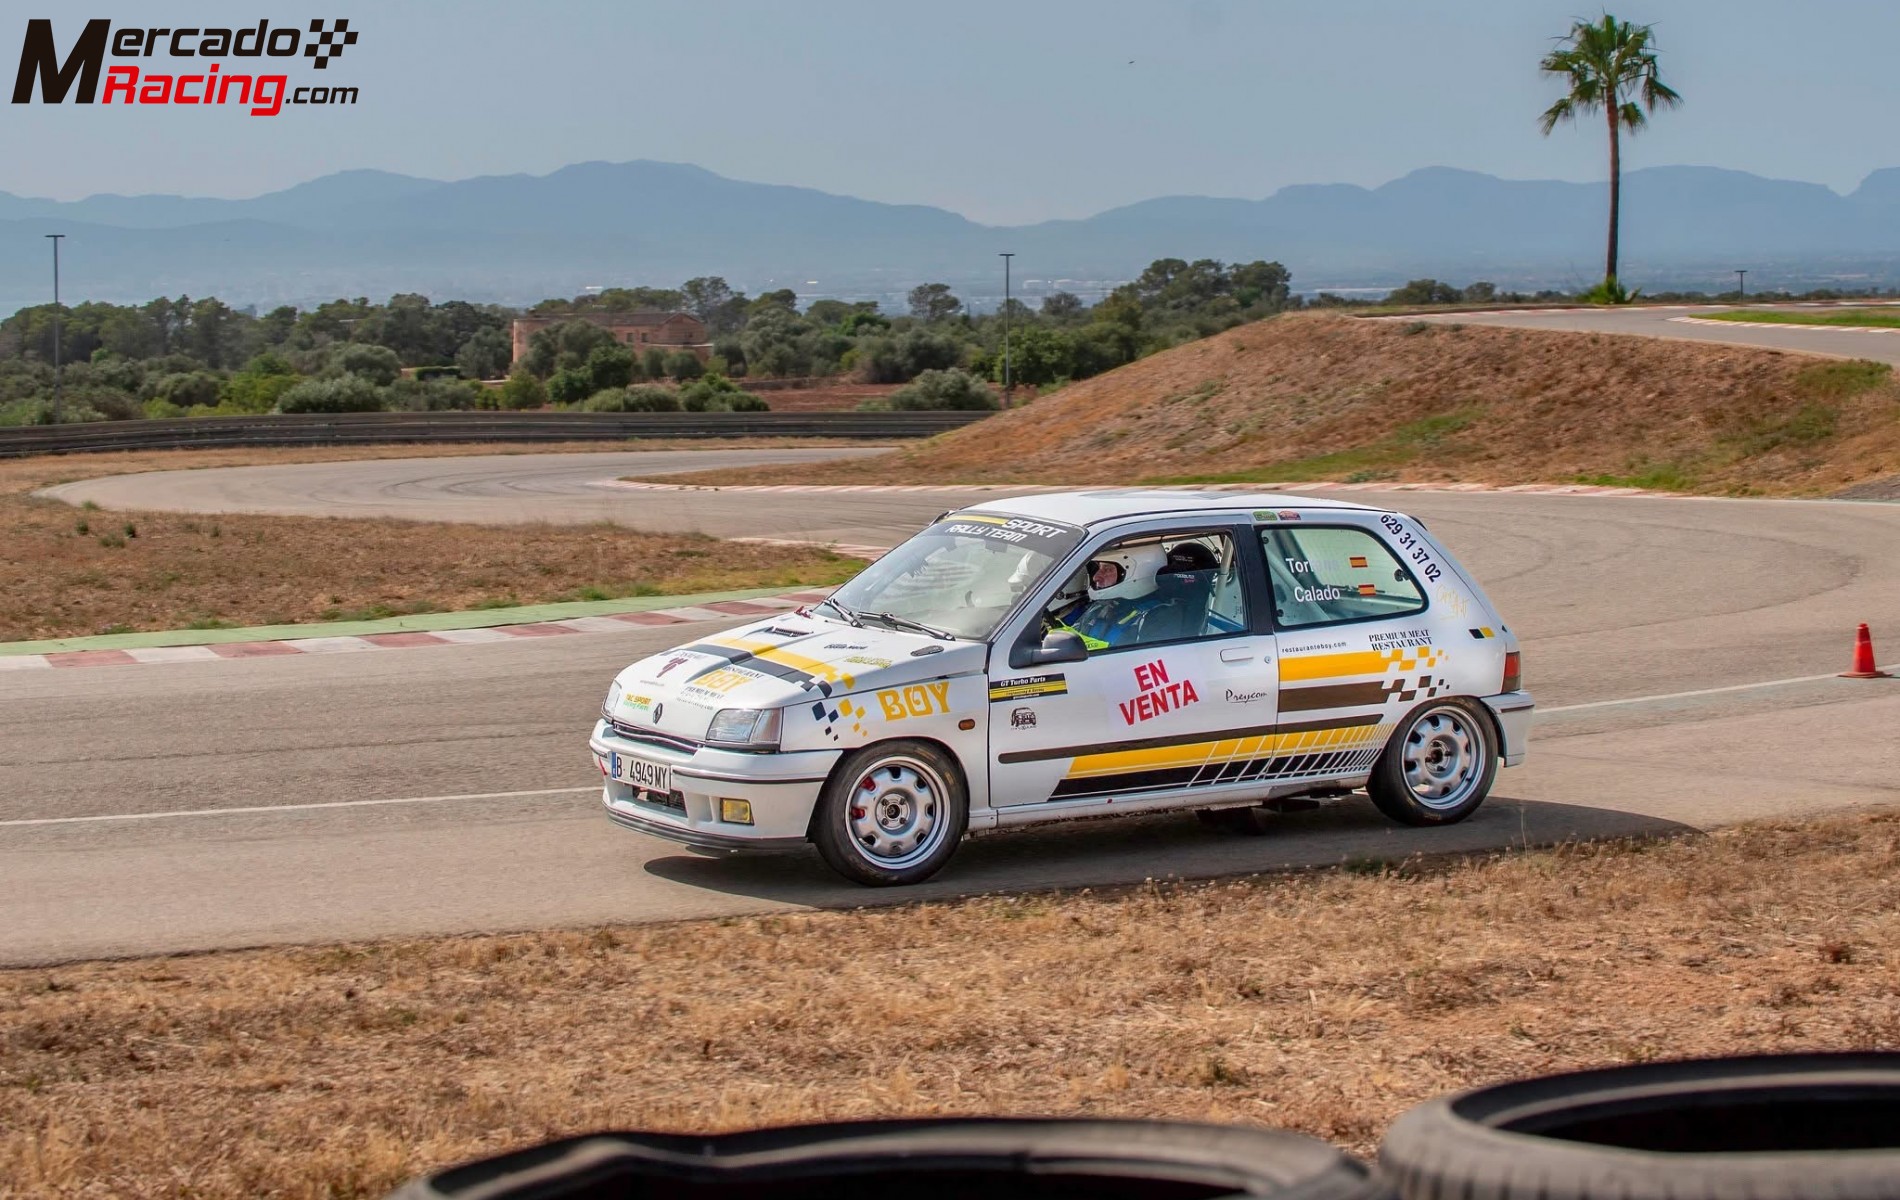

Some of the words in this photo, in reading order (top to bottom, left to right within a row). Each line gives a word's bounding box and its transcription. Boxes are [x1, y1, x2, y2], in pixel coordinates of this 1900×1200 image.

[944, 524, 990, 535] RALLY
[984, 527, 1028, 543] TEAM
[1001, 519, 1068, 538] SPORT
[1380, 514, 1403, 535] 629
[1399, 532, 1417, 550] 31
[1412, 547, 1430, 565] 37
[1424, 563, 1442, 583] 02
[1294, 584, 1341, 602] Calado
[1368, 631, 1406, 642] PREMIUM
[1407, 629, 1430, 637] MEAT
[1371, 636, 1433, 651] RESTAURANT
[1133, 659, 1170, 692] EN
[876, 681, 951, 721] BOY
[1119, 679, 1200, 726] VENTA
[616, 756, 623, 778] B
